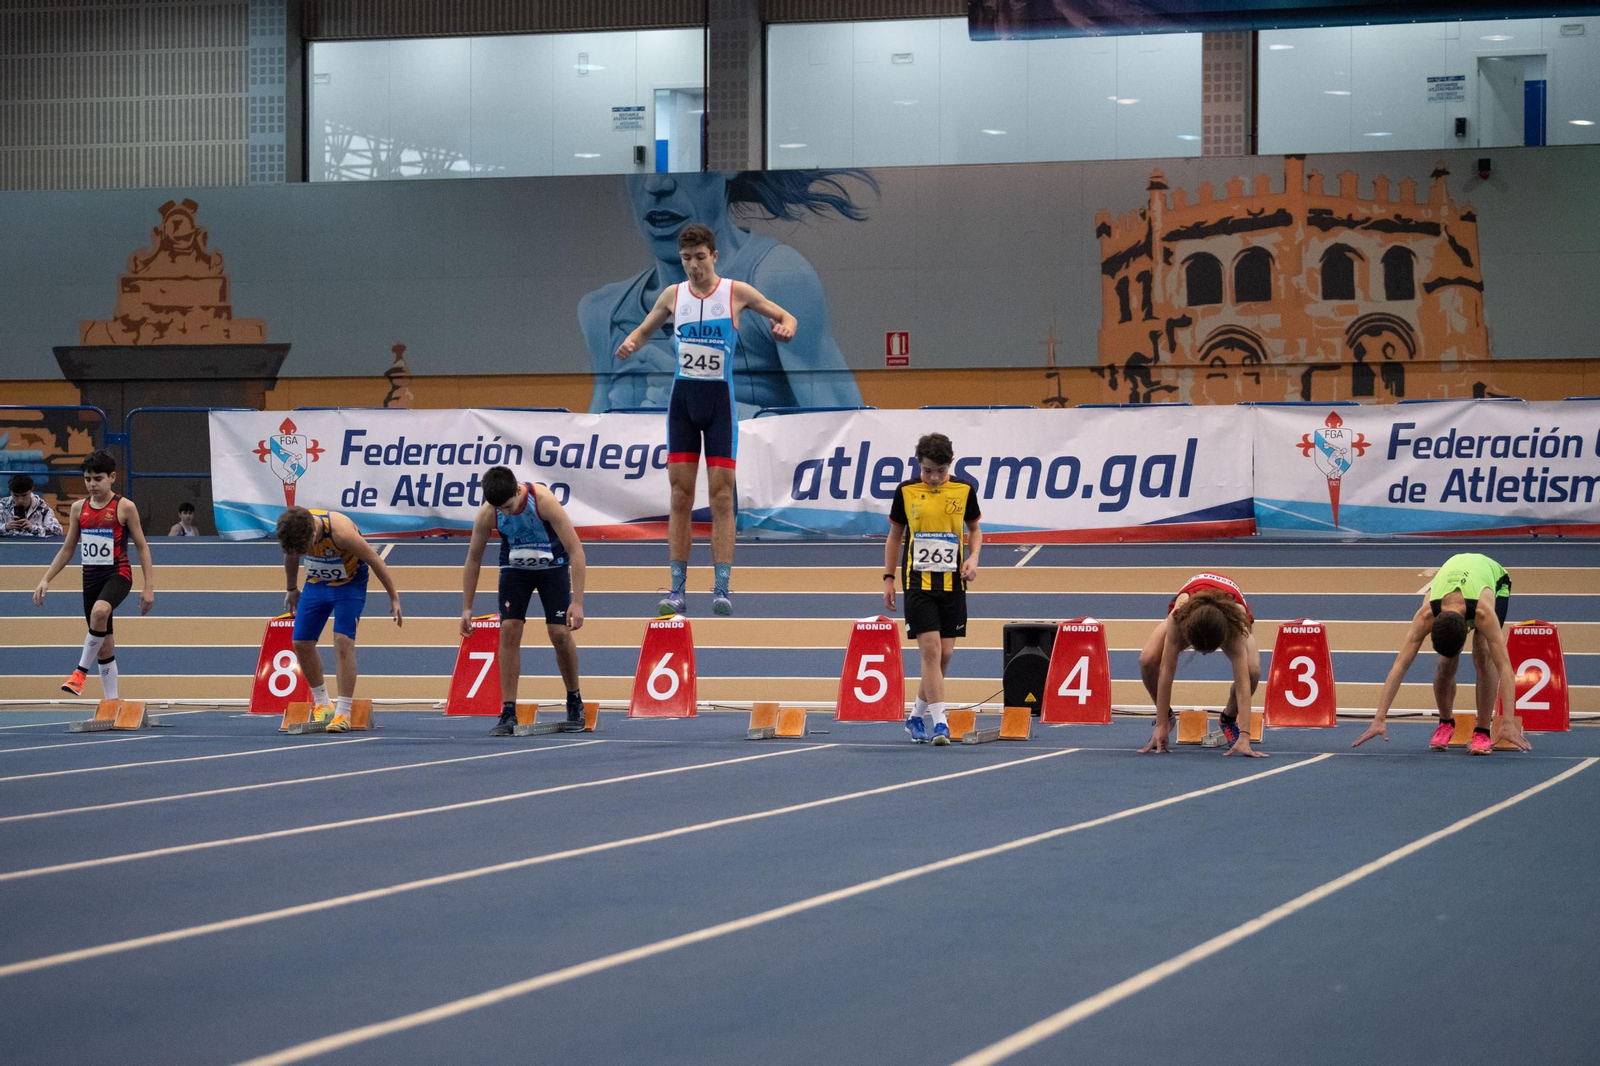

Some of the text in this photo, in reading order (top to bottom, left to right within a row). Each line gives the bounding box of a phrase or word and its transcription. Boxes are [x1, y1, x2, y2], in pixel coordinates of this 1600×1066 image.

[683, 354, 720, 370] 245
[279, 436, 299, 446] FGA
[340, 429, 523, 466] Federación
[1324, 430, 1344, 439] FGA
[1387, 422, 1583, 460] Federación
[340, 481, 377, 508] de
[1388, 475, 1427, 503] de
[82, 543, 111, 557] 306
[919, 548, 954, 564] 263
[308, 568, 342, 580] 359
[856, 623, 893, 631] MONDO
[1282, 626, 1321, 634] MONDO
[268, 649, 298, 698] 8
[466, 651, 495, 698] 7
[646, 652, 680, 701] 6
[853, 654, 888, 704] 5
[1057, 655, 1093, 705] 4
[1284, 655, 1319, 708] 3
[1515, 658, 1551, 710] 2
